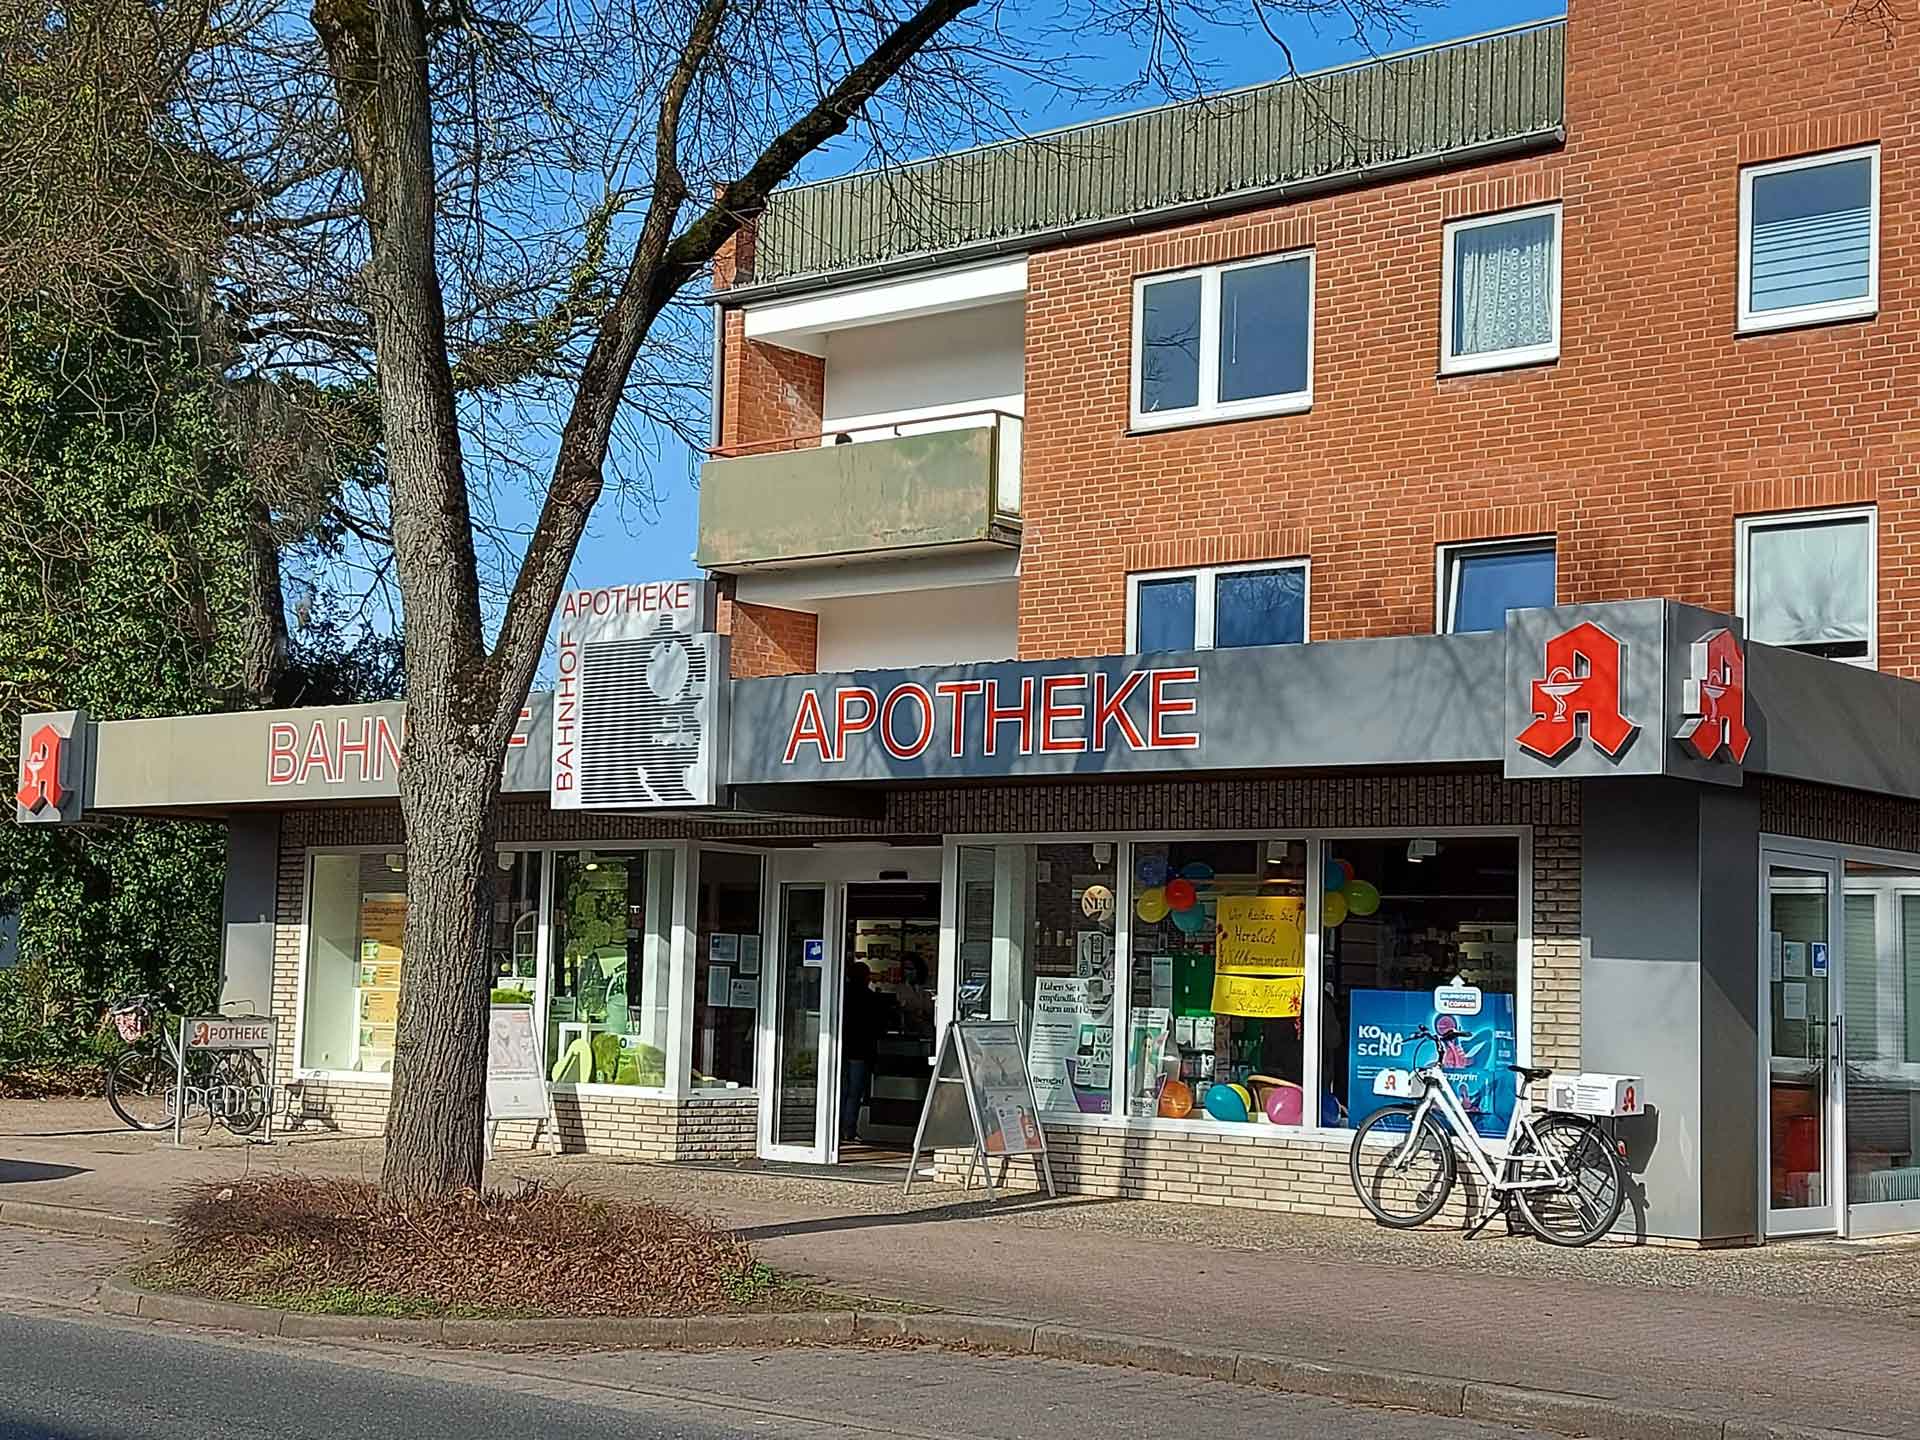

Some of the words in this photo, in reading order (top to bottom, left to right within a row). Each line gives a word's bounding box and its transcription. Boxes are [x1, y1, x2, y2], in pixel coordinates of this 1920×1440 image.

[562, 583, 690, 619] APOTHEKE
[556, 631, 578, 791] BAHNHOF
[782, 666, 1200, 764] APOTHEKE
[1084, 896, 1113, 910] NEU
[1234, 924, 1277, 945] Herzlich
[1040, 981, 1064, 991] Haben
[191, 1022, 269, 1045] APOTHEKE
[1357, 1043, 1402, 1057] SCHU
